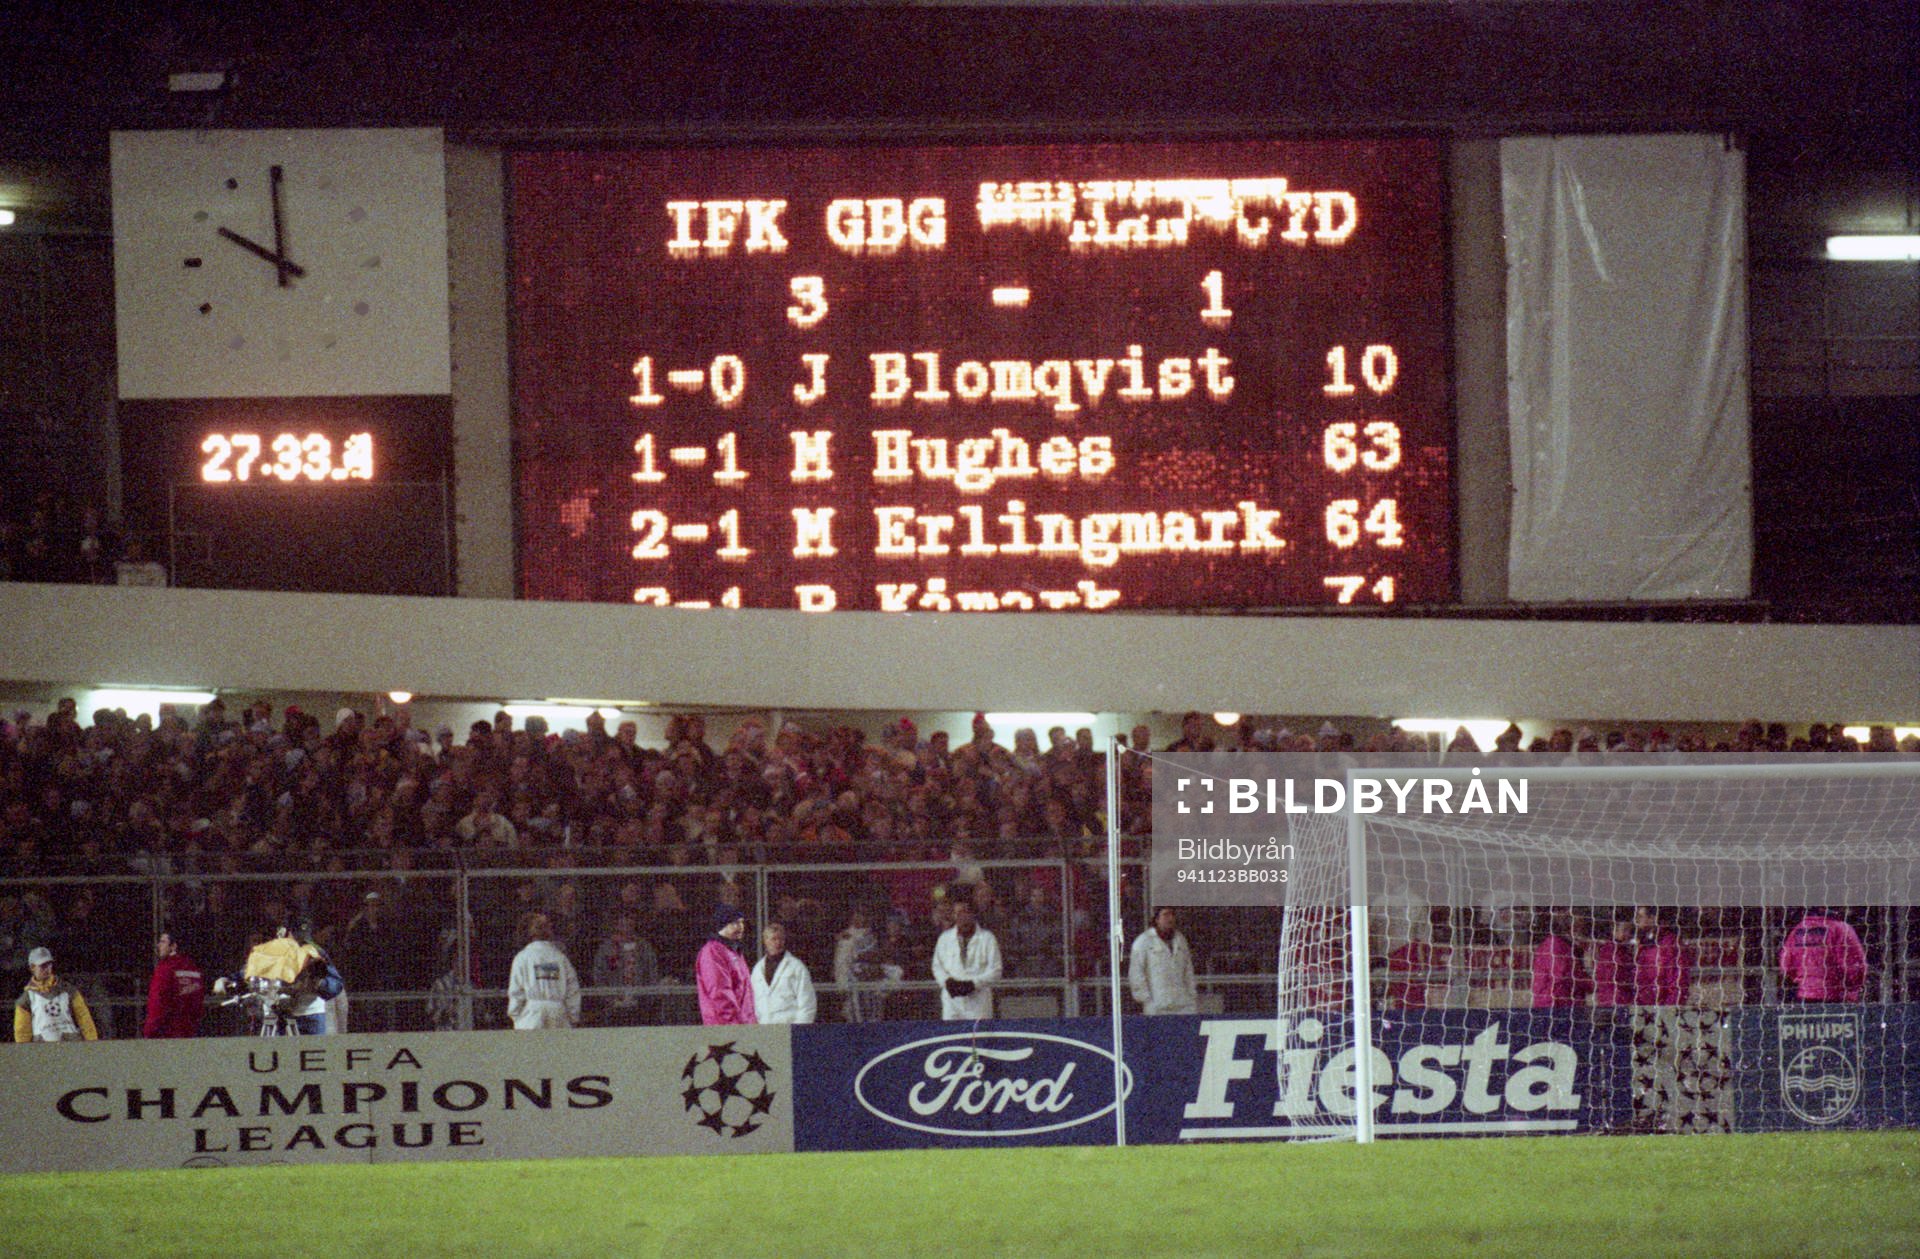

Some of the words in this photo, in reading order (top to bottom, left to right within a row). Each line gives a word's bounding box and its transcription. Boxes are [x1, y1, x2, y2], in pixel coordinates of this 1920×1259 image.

[667, 200, 788, 254] IFK
[827, 198, 947, 252] GBG
[787, 276, 829, 325] 3
[1201, 271, 1232, 320] 1
[630, 355, 745, 404] 1-0
[794, 353, 830, 401] J
[869, 345, 1235, 417] Blomqvist
[1323, 345, 1399, 394] 10
[202, 433, 373, 482] 27.33.
[631, 432, 749, 485] 1-1
[790, 430, 834, 480] M
[872, 427, 1115, 493] Hughes
[1323, 421, 1402, 472] 63
[631, 508, 751, 560] 2-1
[791, 507, 838, 557] M
[874, 500, 1286, 567] Erlingmark
[1324, 499, 1404, 548] 64
[1780, 1022, 1855, 1041] PHILIPS
[248, 1047, 423, 1073] UEFA
[908, 1045, 1077, 1116] Ford
[1183, 1018, 1582, 1119] Fiesta
[55, 1074, 614, 1124] CHAMPIONS
[192, 1121, 485, 1153] LEAGUE
